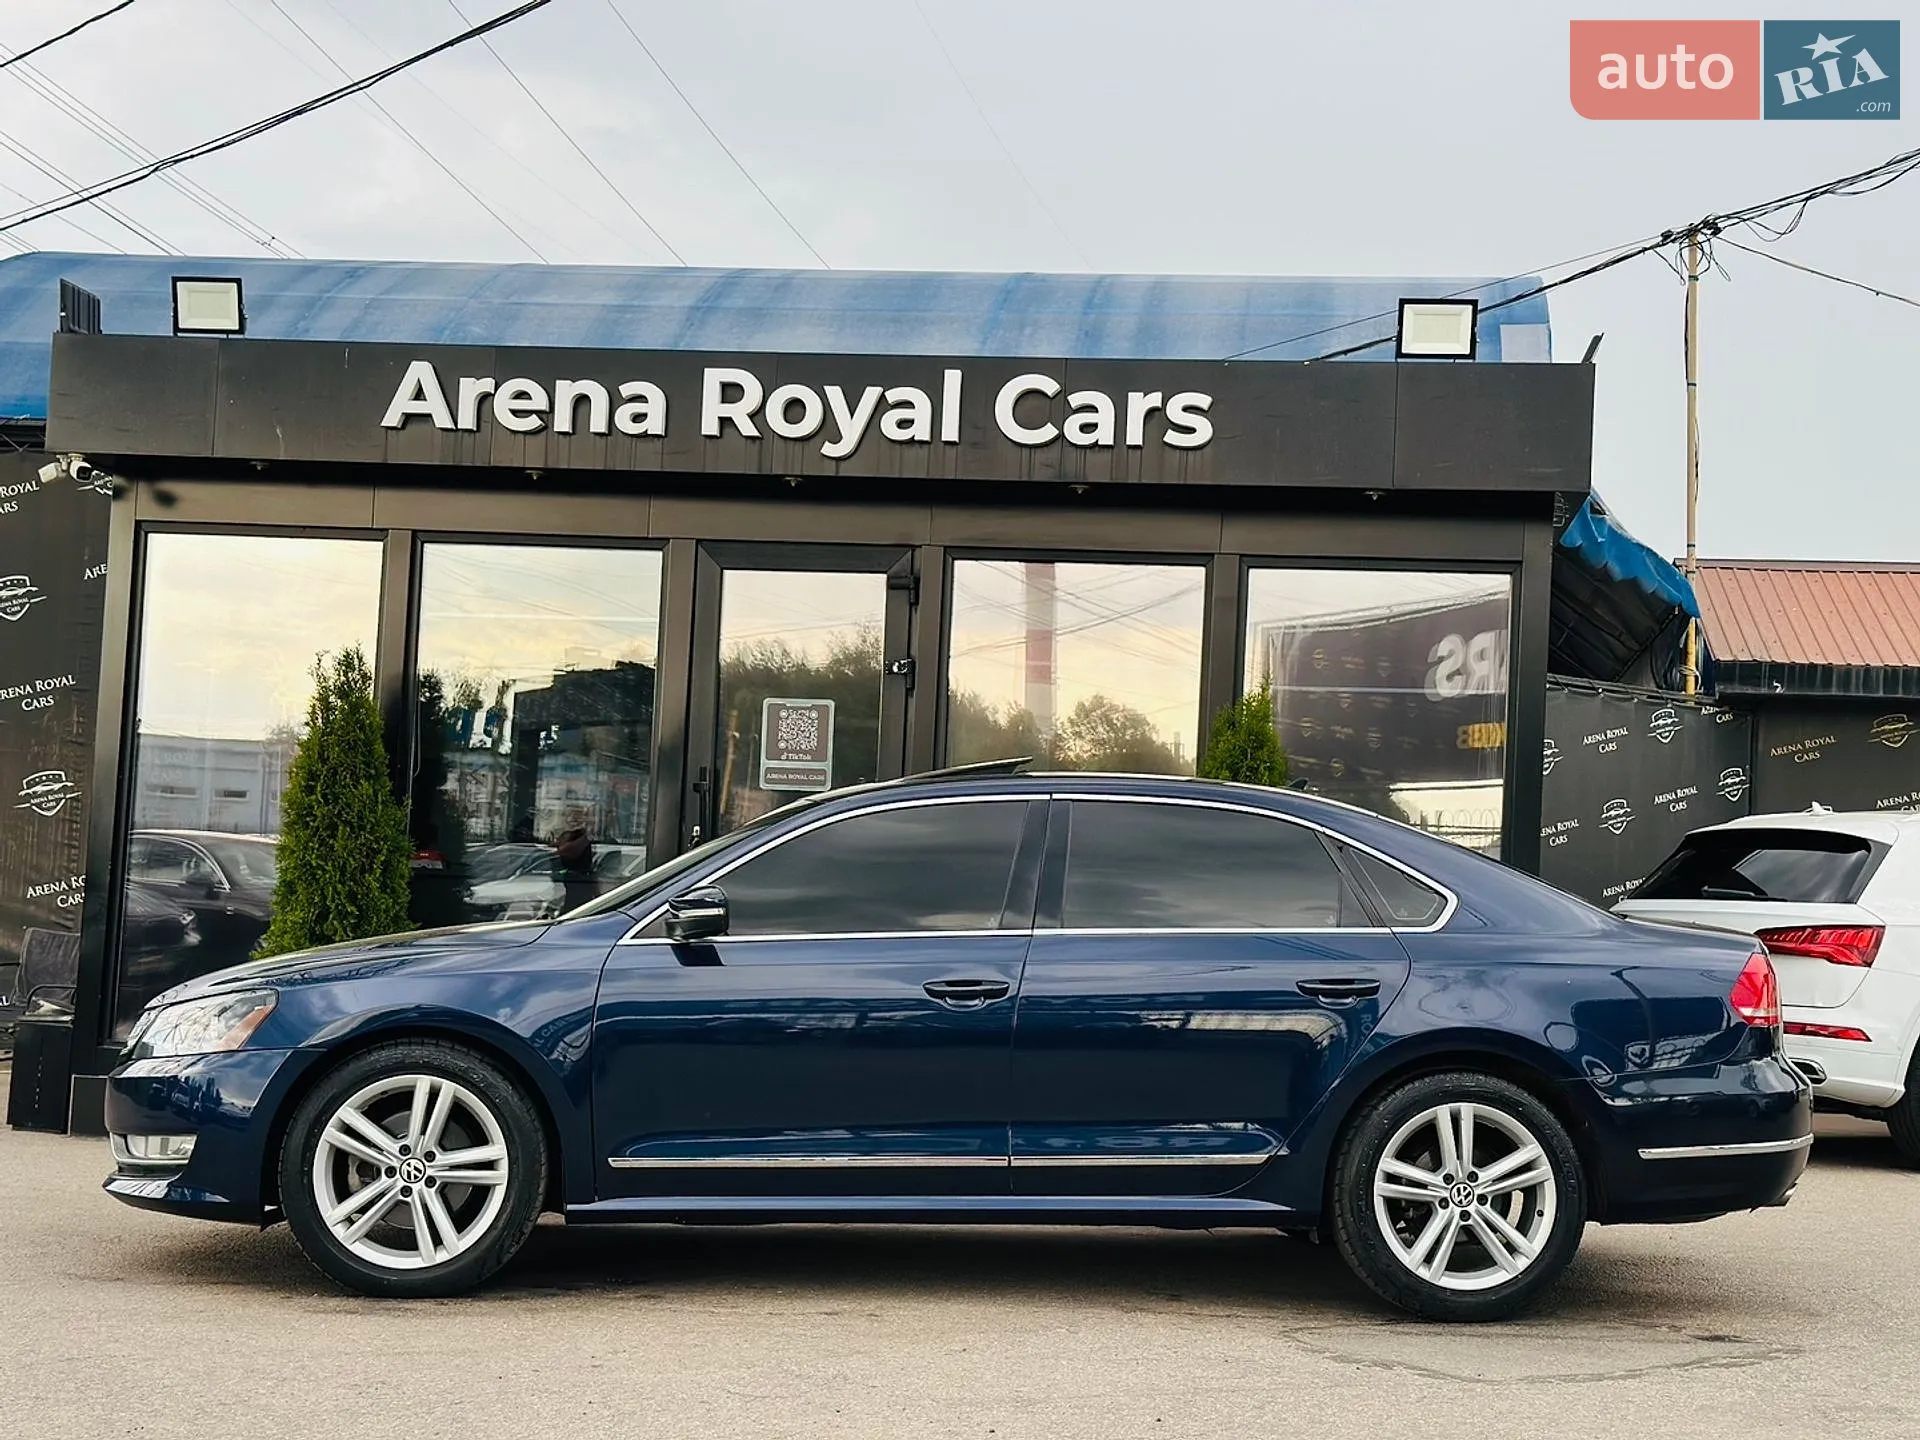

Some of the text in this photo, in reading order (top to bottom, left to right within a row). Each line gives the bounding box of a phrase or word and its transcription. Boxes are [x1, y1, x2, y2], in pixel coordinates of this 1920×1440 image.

[380, 360, 1214, 459] Arena Royal Cars
[0, 480, 40, 498] ROYAL
[35, 674, 77, 692] ROYAL
[21, 694, 55, 711] CARS
[1770, 735, 1837, 757] ARENA ROYAL
[1794, 751, 1821, 763] CARS
[1876, 795, 1910, 809] ARENA
[26, 881, 69, 899] ARENA
[56, 893, 85, 908] CAR
